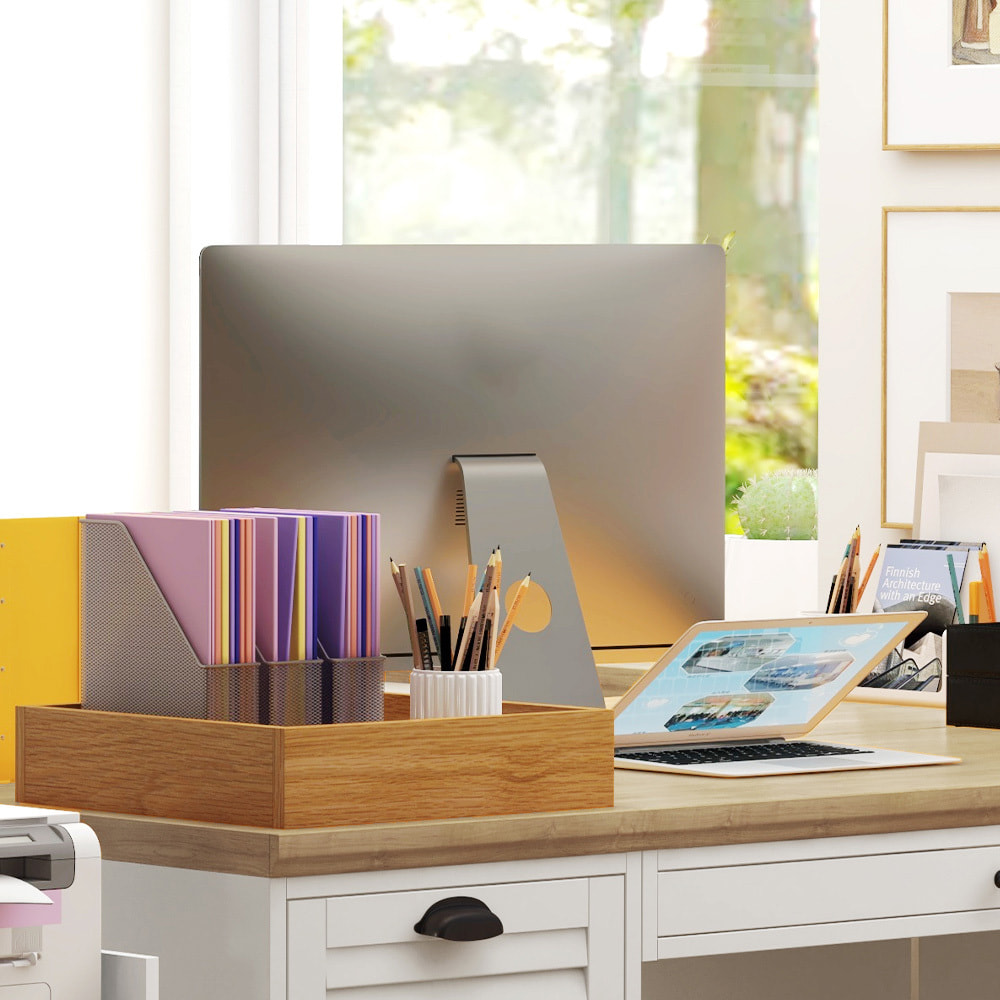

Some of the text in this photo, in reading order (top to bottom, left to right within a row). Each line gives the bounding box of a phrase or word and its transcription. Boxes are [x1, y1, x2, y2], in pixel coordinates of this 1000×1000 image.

[885, 566, 921, 578] Finnish
[882, 578, 941, 592] Architecture
[880, 590, 942, 606] with an Edge
